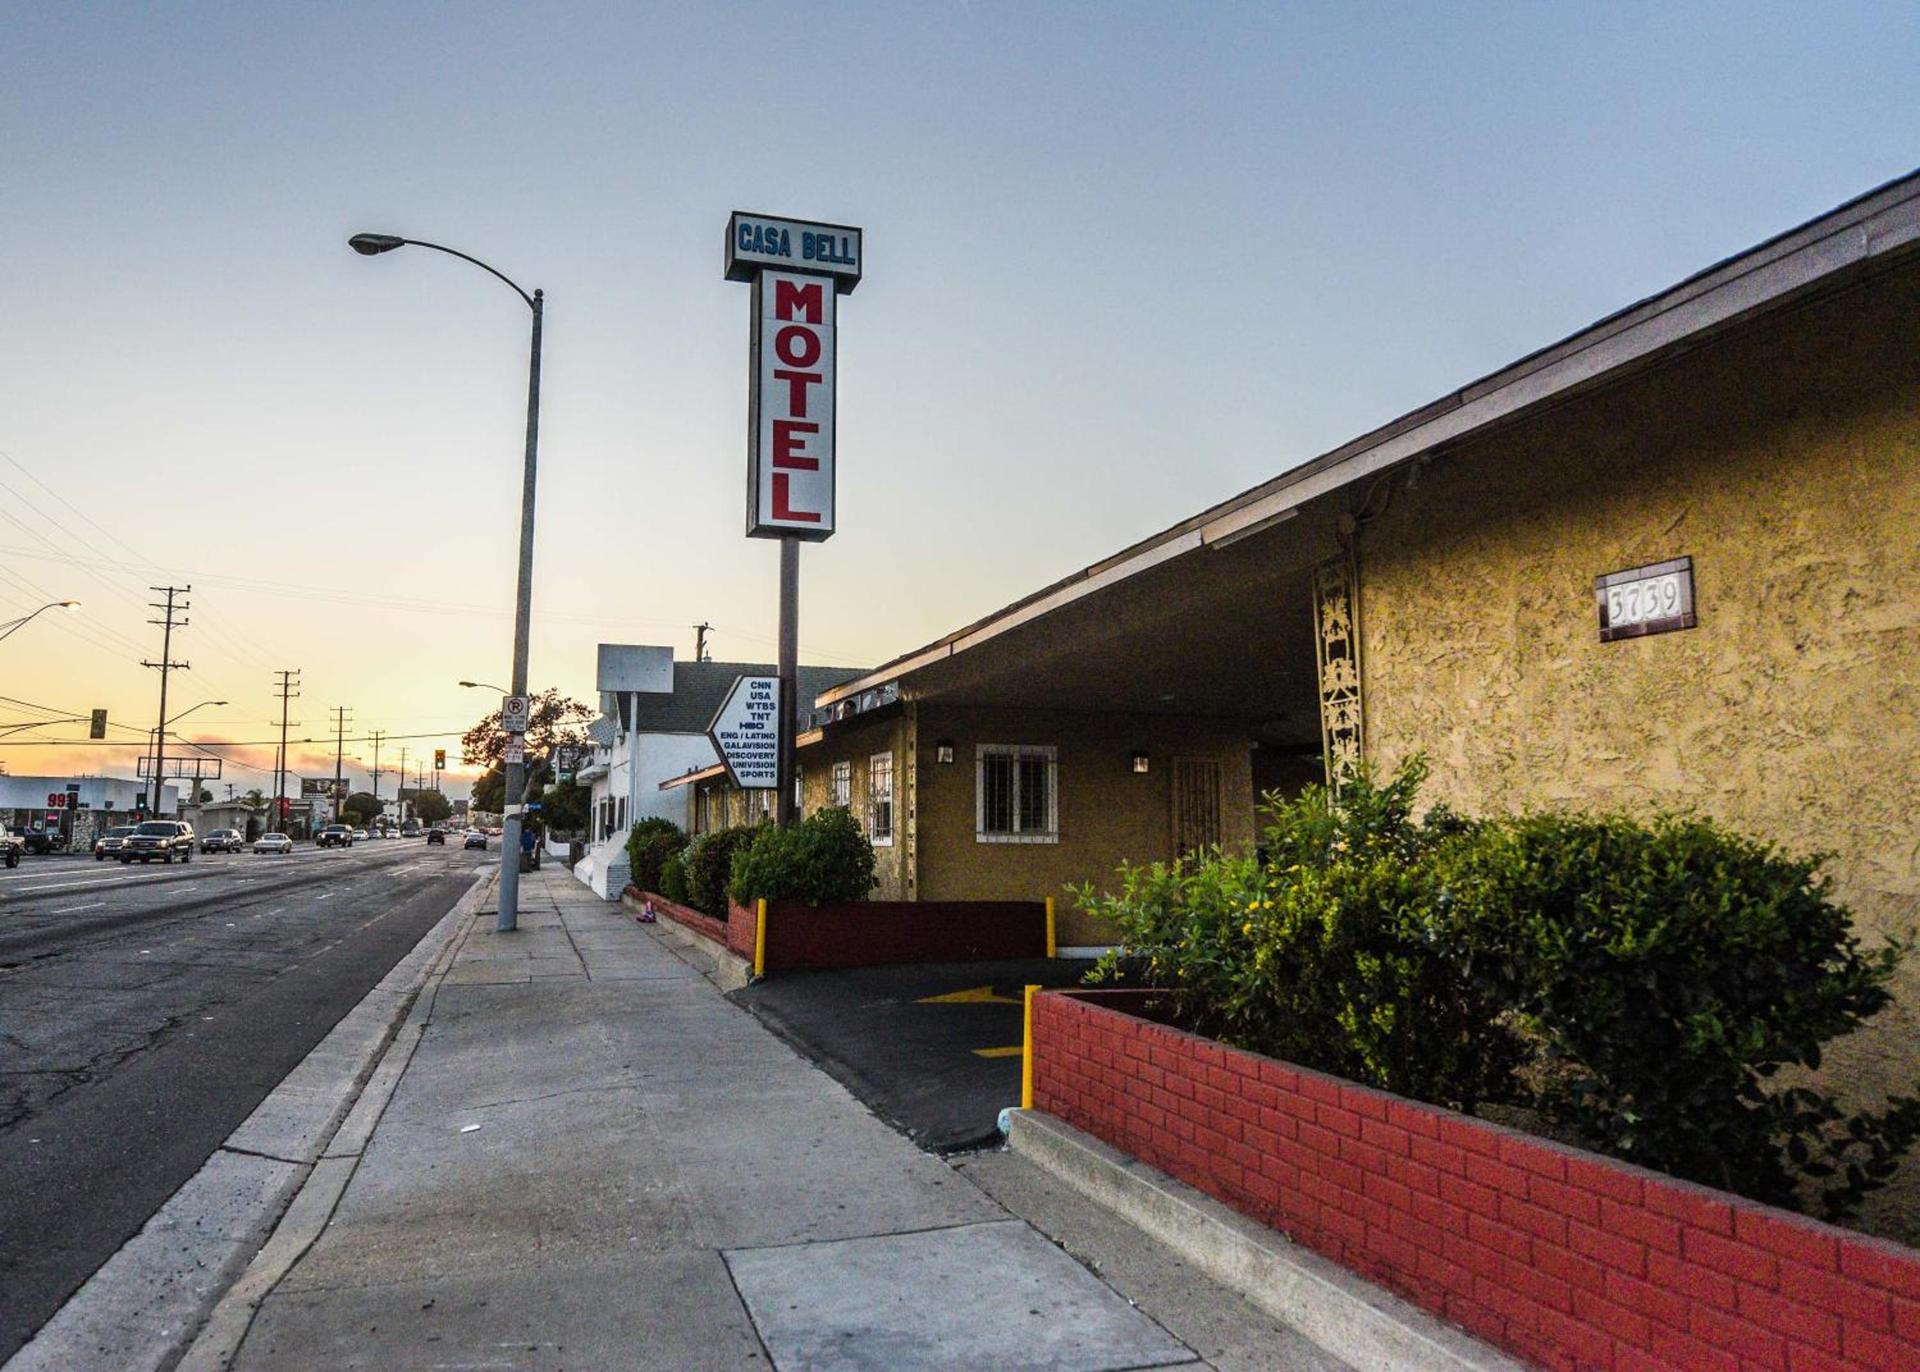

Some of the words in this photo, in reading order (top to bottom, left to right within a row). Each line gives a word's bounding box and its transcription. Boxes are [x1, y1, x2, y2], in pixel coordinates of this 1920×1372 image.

[738, 222, 791, 258] CASA
[802, 231, 856, 266] BELL
[771, 279, 823, 523] MOTEL
[1611, 582, 1677, 620] 3739
[750, 681, 771, 690] CNN
[750, 692, 770, 700] USA
[746, 702, 776, 710] WTBS
[751, 712, 771, 720] TNT
[732, 761, 775, 769] UNIVISION
